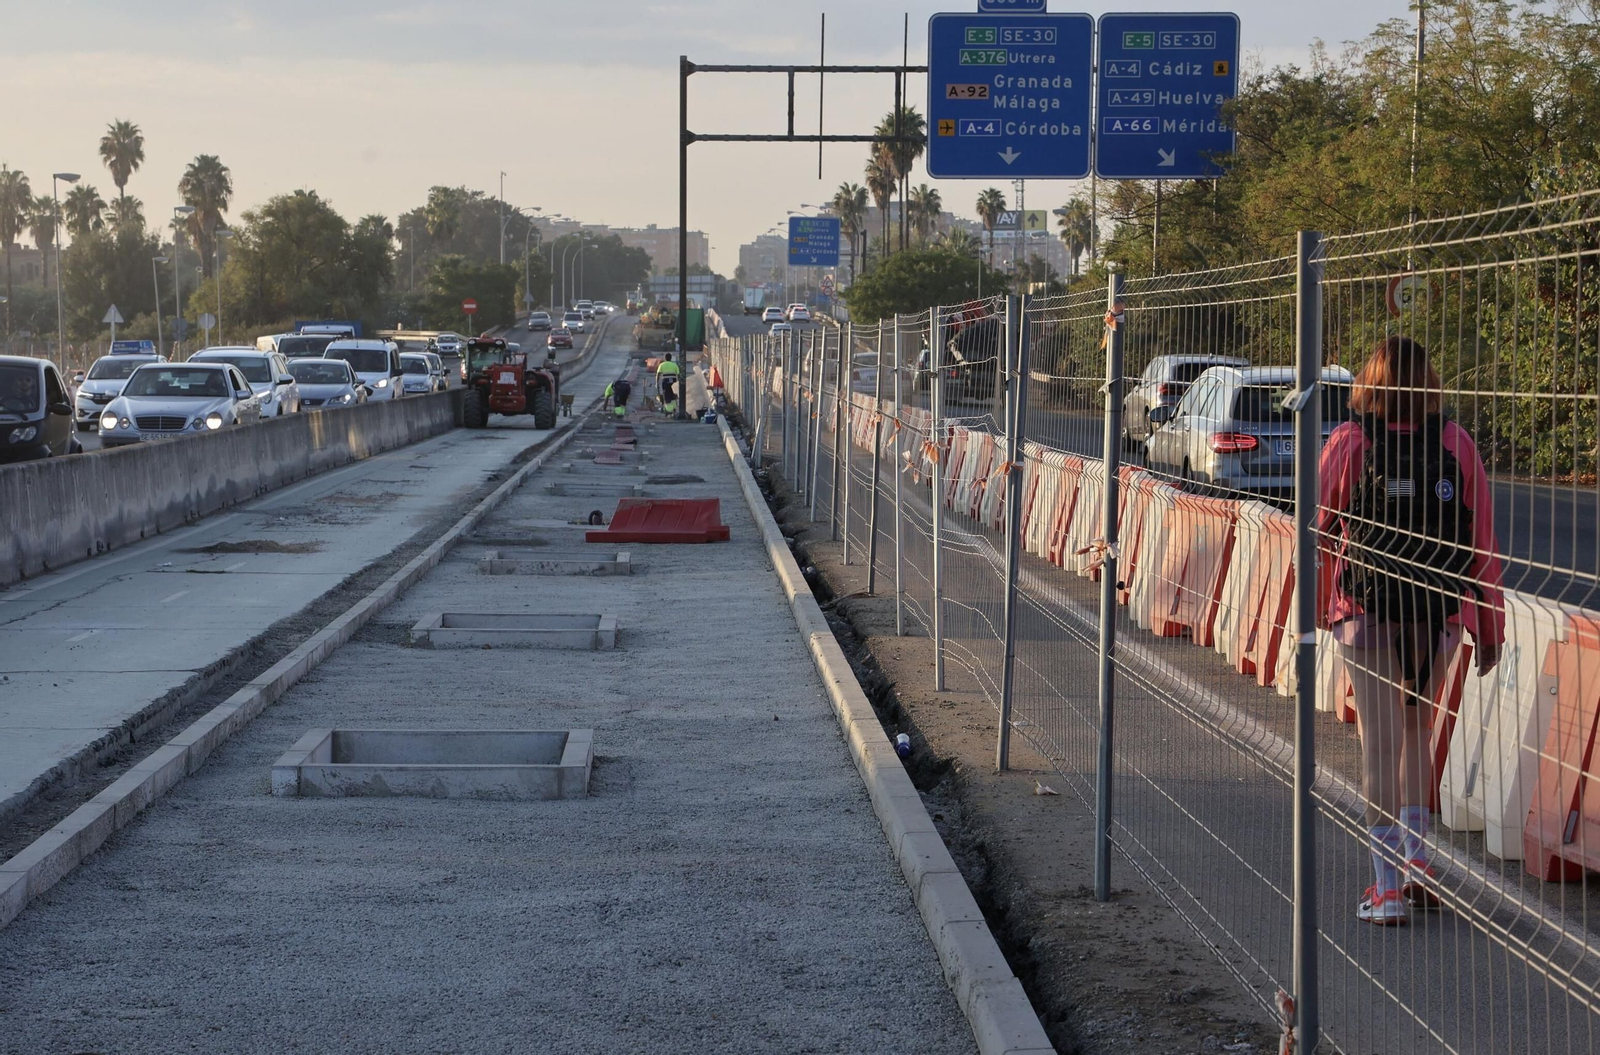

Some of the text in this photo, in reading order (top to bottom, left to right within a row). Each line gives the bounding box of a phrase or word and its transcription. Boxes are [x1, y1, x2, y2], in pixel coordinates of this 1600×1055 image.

[968, 30, 1054, 42] E-5 SE-30
[1125, 35, 1213, 47] E-5 SE-30
[961, 51, 1056, 64] A-376 Utrera
[1108, 60, 1203, 76] A-4 Cádiz
[993, 73, 1073, 89] Granada
[948, 85, 988, 98] A-92
[1111, 91, 1224, 105] A-49 Huelva
[993, 94, 1061, 113] Málaga
[966, 121, 1082, 136] A-4 Córdoba
[1112, 118, 1227, 133] A-66 Mérida
[808, 240, 831, 248] Málaga
